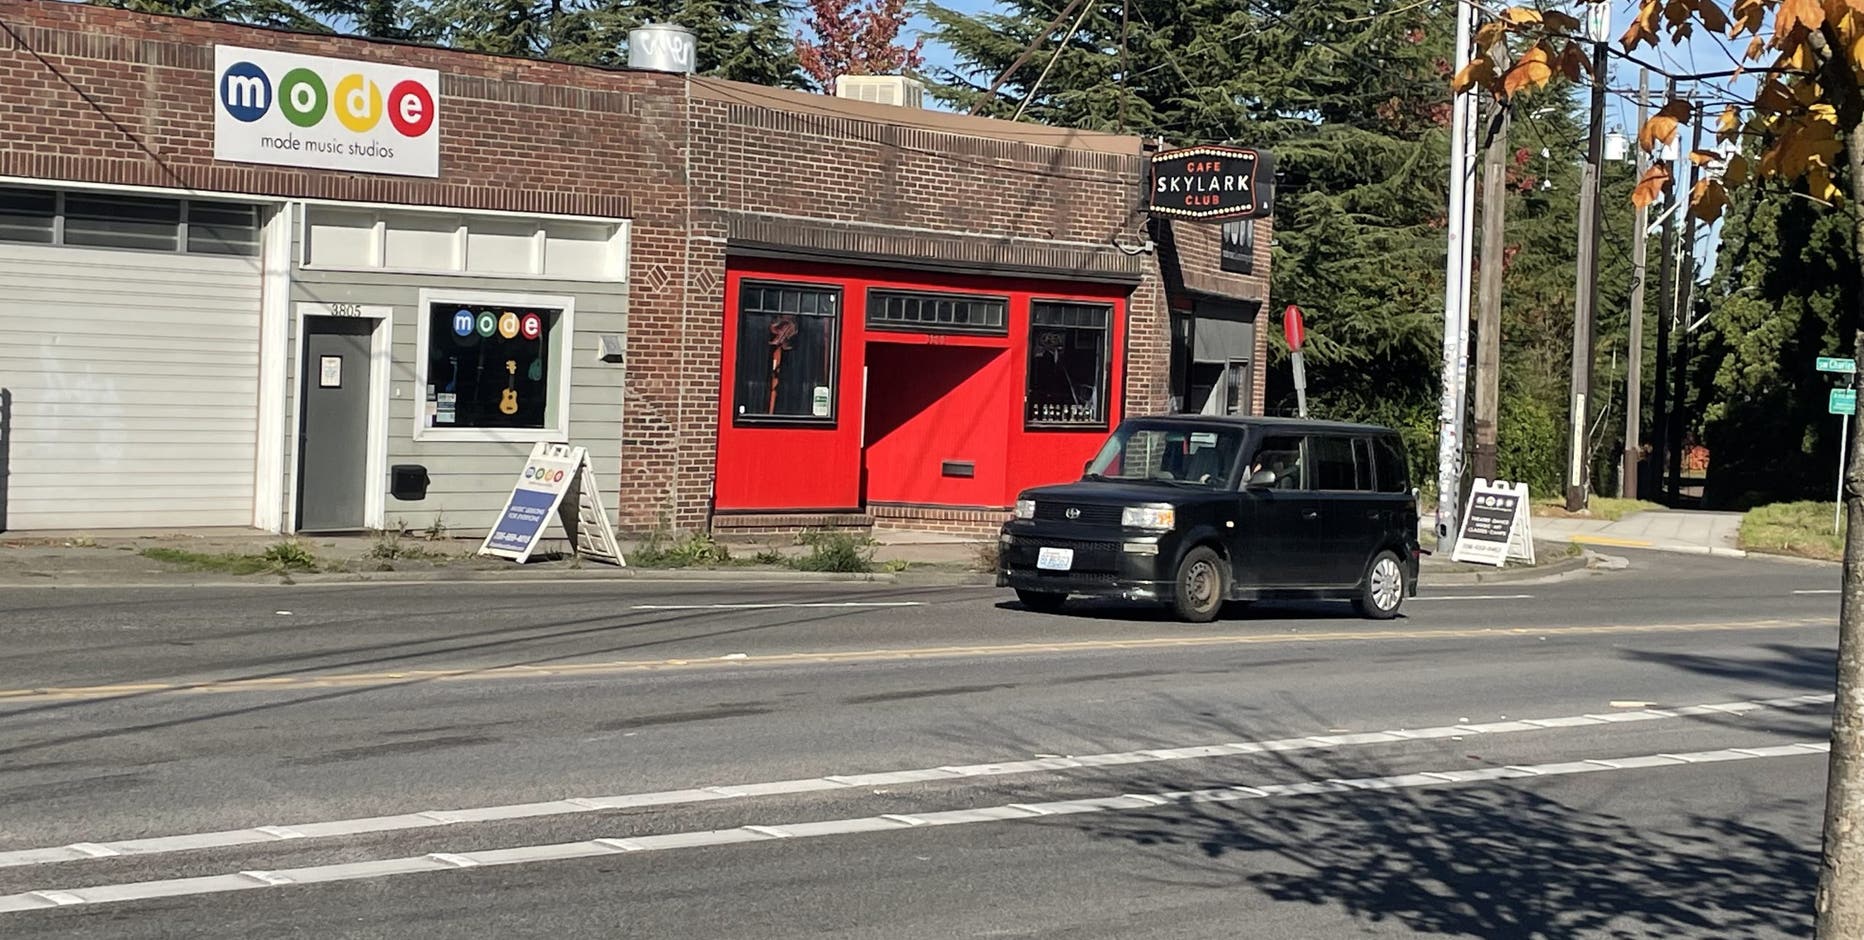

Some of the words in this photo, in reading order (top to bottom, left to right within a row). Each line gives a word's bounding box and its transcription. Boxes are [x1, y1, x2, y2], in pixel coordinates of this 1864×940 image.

[226, 73, 425, 126] mode
[261, 132, 300, 150] mode
[305, 138, 343, 154] music
[348, 141, 394, 158] studios
[1187, 162, 1221, 173] CAFE
[1157, 175, 1249, 192] SKYLARK
[1185, 195, 1220, 205] CLUB
[332, 303, 361, 317] 3805
[455, 312, 539, 336] mode
